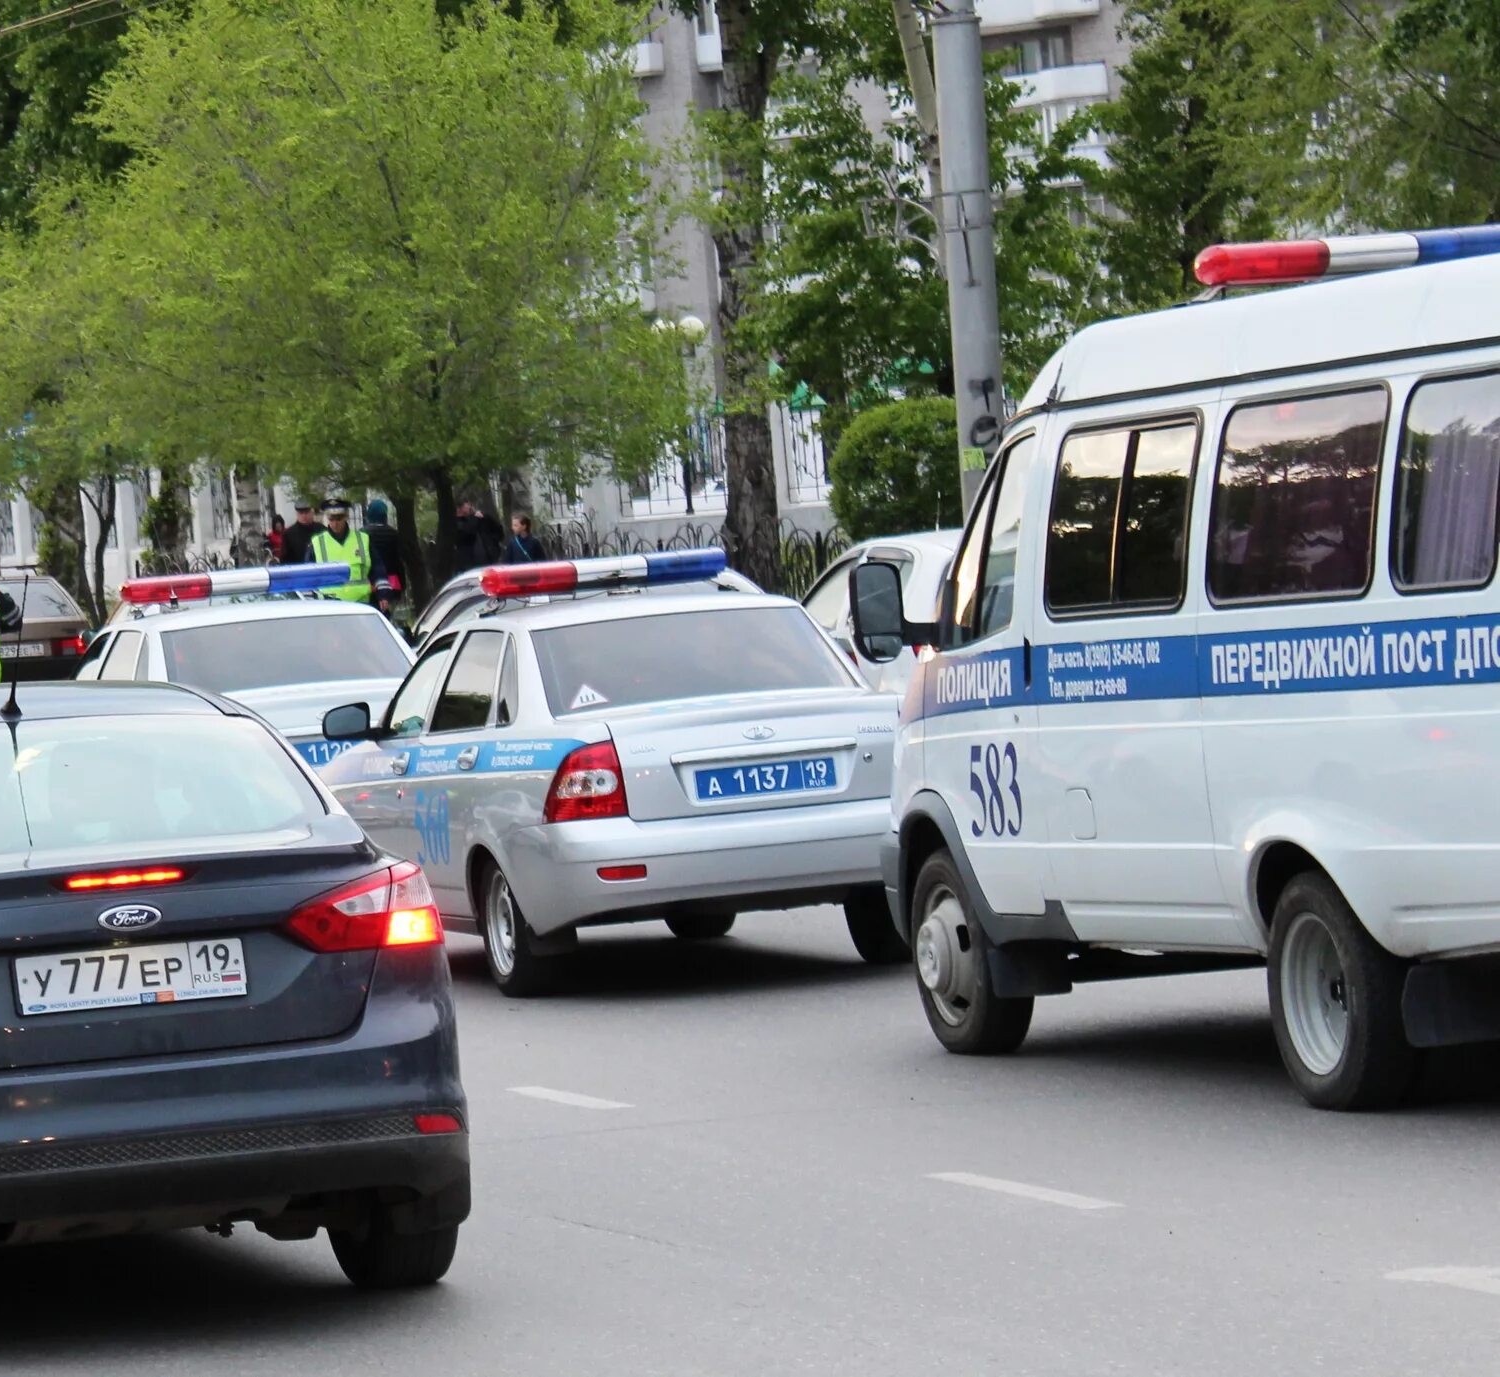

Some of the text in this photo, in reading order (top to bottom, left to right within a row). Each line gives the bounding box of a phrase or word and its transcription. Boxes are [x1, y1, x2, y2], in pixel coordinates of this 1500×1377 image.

[1211, 626, 1376, 690] ПЕРЕДВИЖНОЙ
[1382, 630, 1447, 675] ПОСТ
[937, 659, 1012, 706] ПОЛИЦИЯ
[708, 760, 828, 797] А 1137 19
[809, 778, 828, 788] RUS
[970, 741, 1022, 837] 583
[112, 909, 149, 927] Ford
[195, 943, 231, 972] 19
[193, 973, 222, 984] RUS
